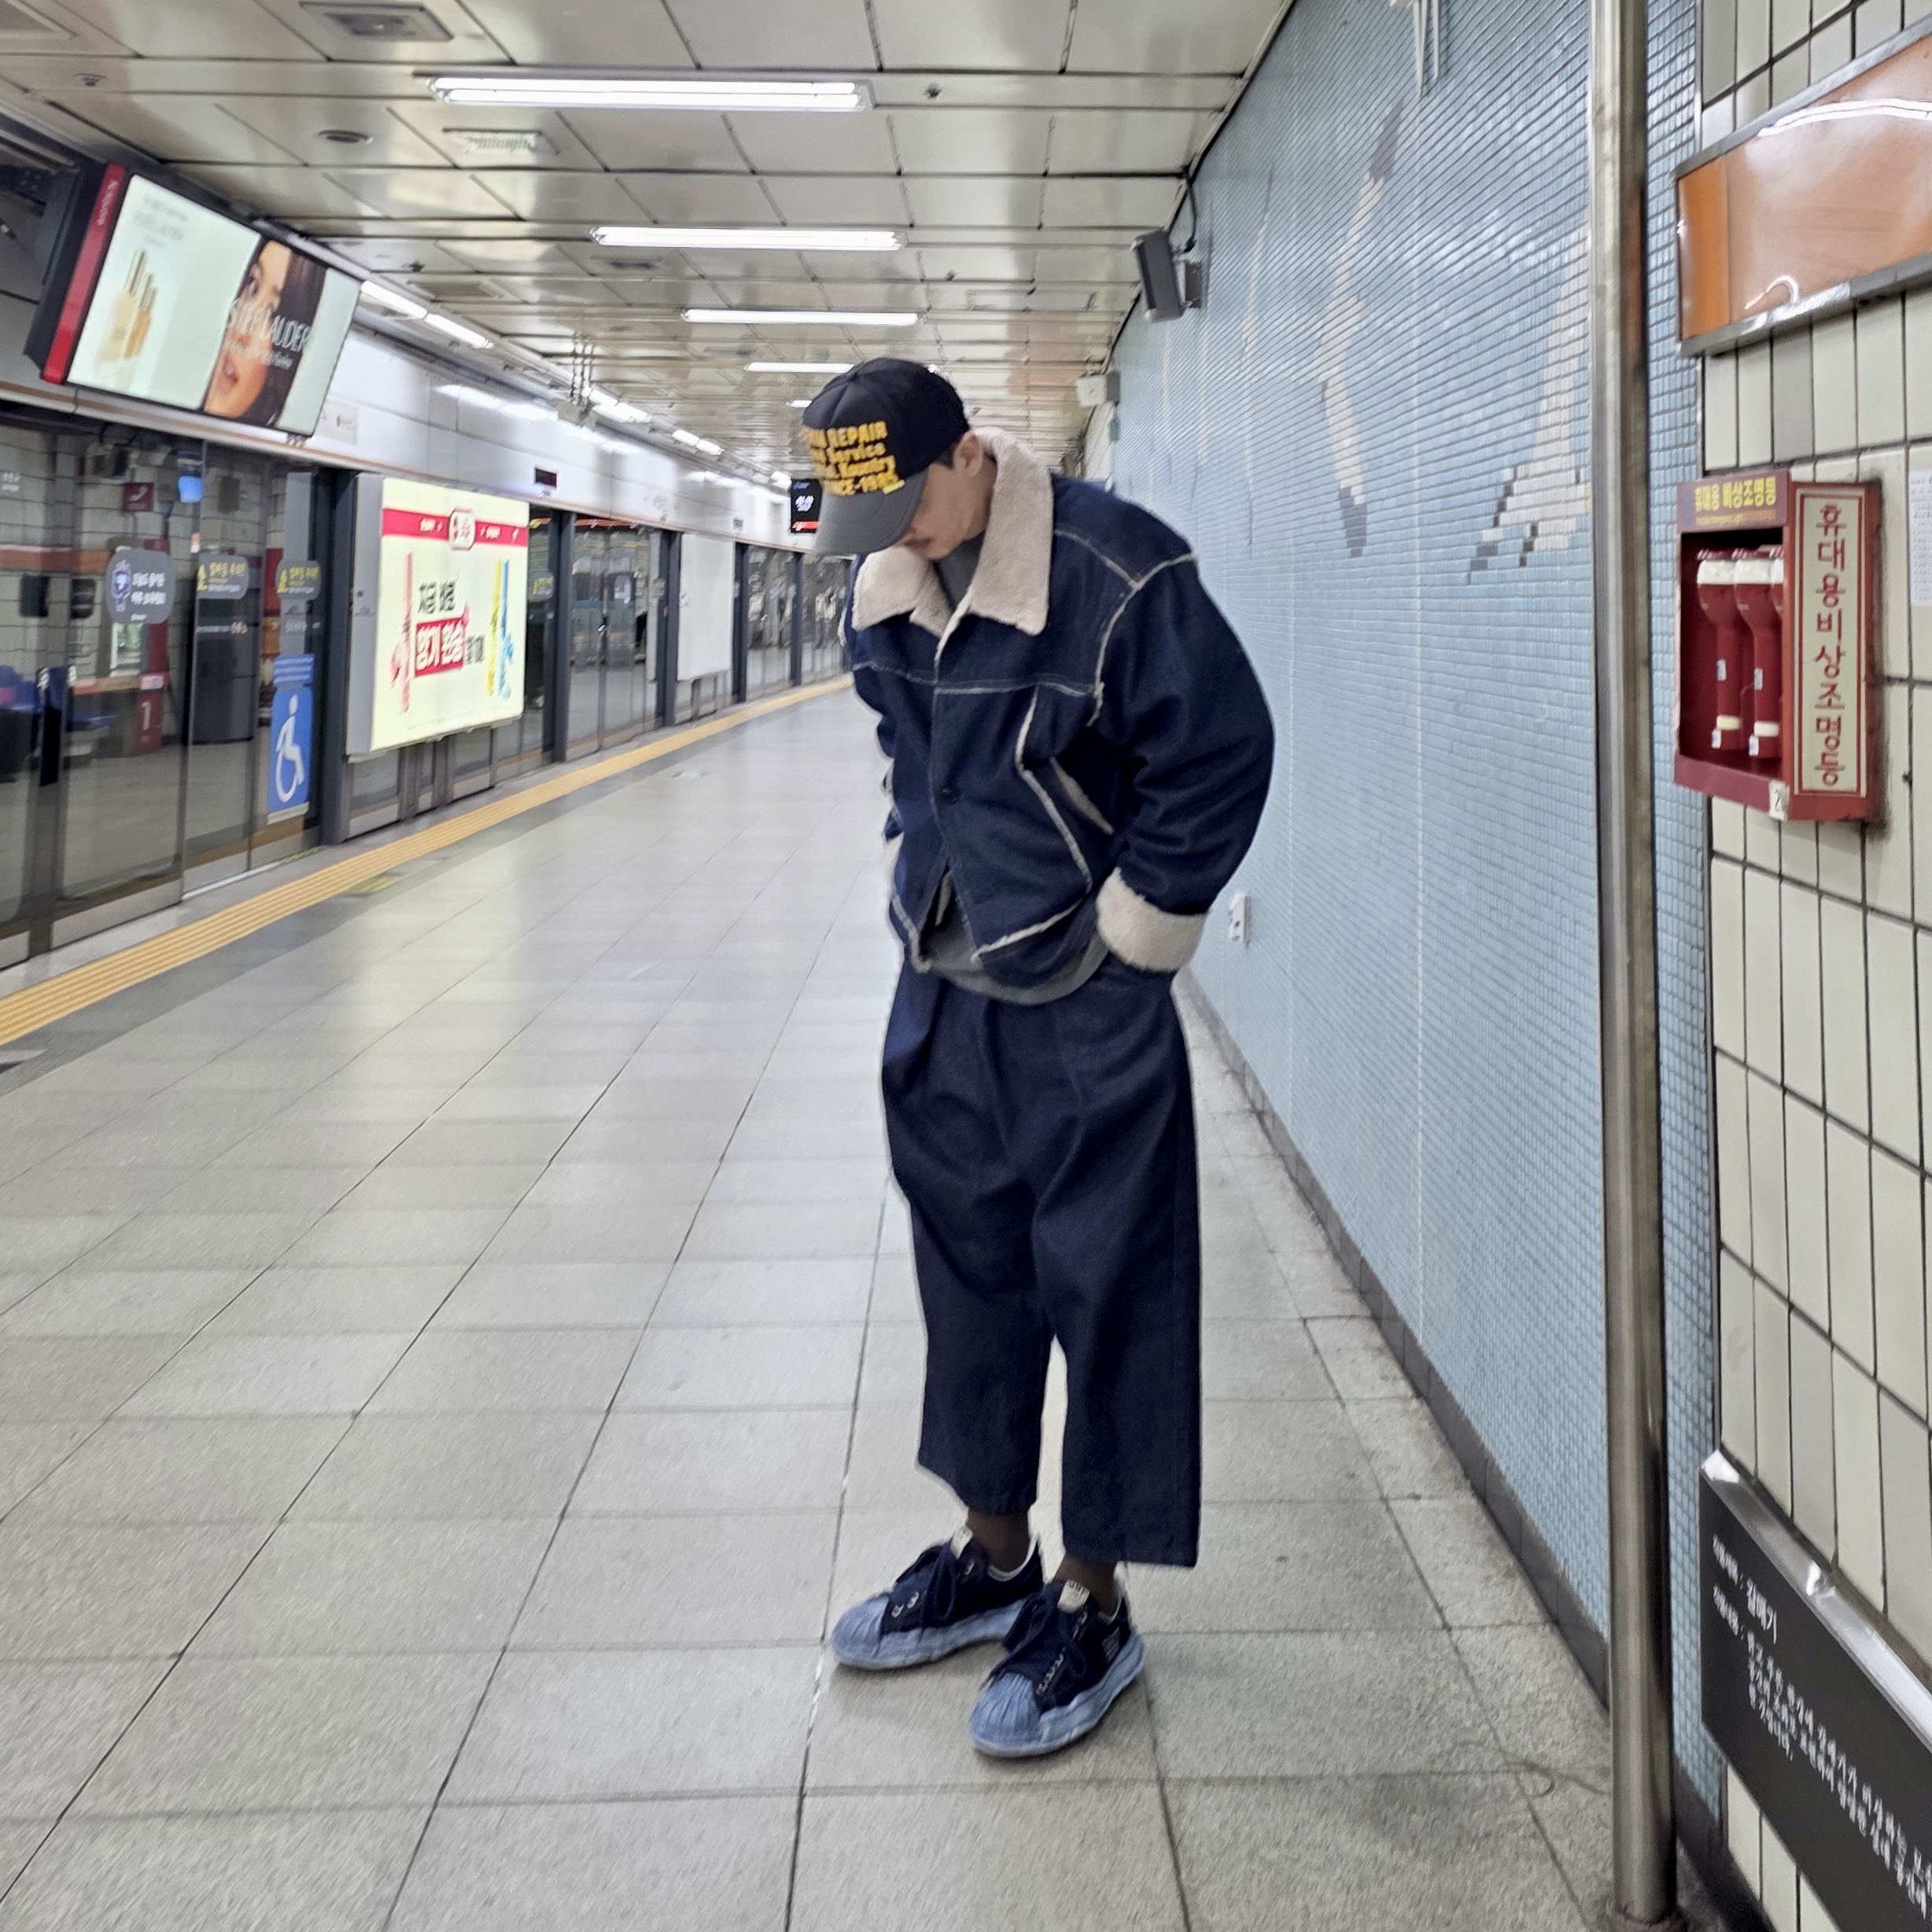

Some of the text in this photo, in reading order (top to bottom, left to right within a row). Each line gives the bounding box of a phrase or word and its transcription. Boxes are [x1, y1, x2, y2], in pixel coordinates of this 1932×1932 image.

[827, 421, 887, 448] REPAIR
[1694, 475, 1776, 512] 휴대용 비상조명등
[1814, 501, 1847, 787] 휴대용비상조명등
[141, 700, 152, 731] 1
[1775, 787, 1782, 813] 2
